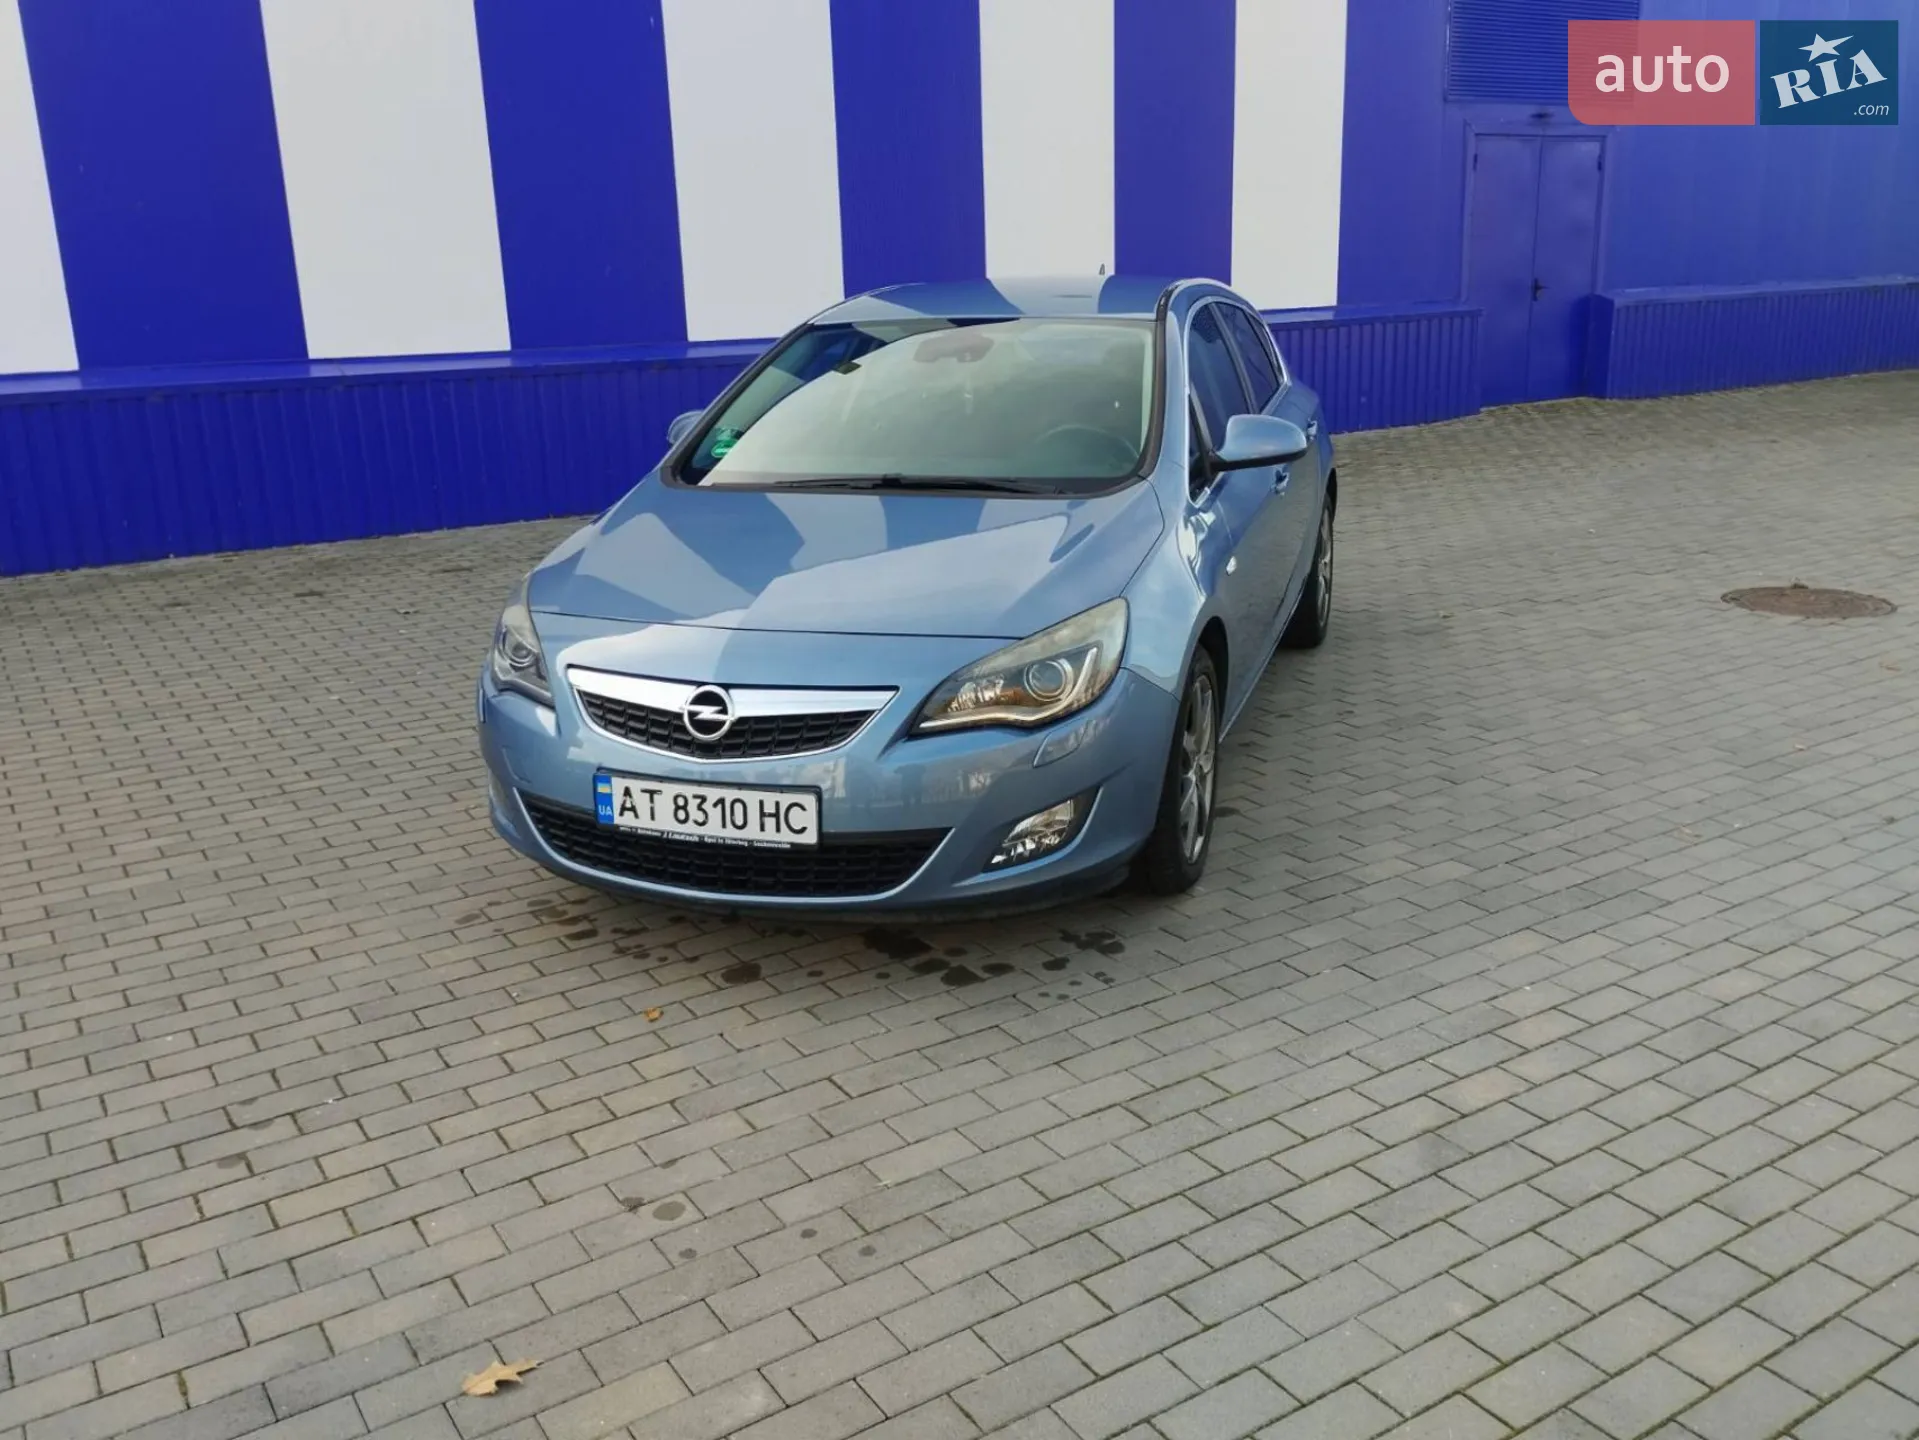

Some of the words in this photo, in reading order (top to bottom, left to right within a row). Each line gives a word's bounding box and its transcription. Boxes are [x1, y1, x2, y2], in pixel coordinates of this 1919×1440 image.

[598, 805, 613, 816] UA
[619, 786, 663, 822] AT
[672, 793, 748, 830] 8310
[758, 799, 808, 835] HC
